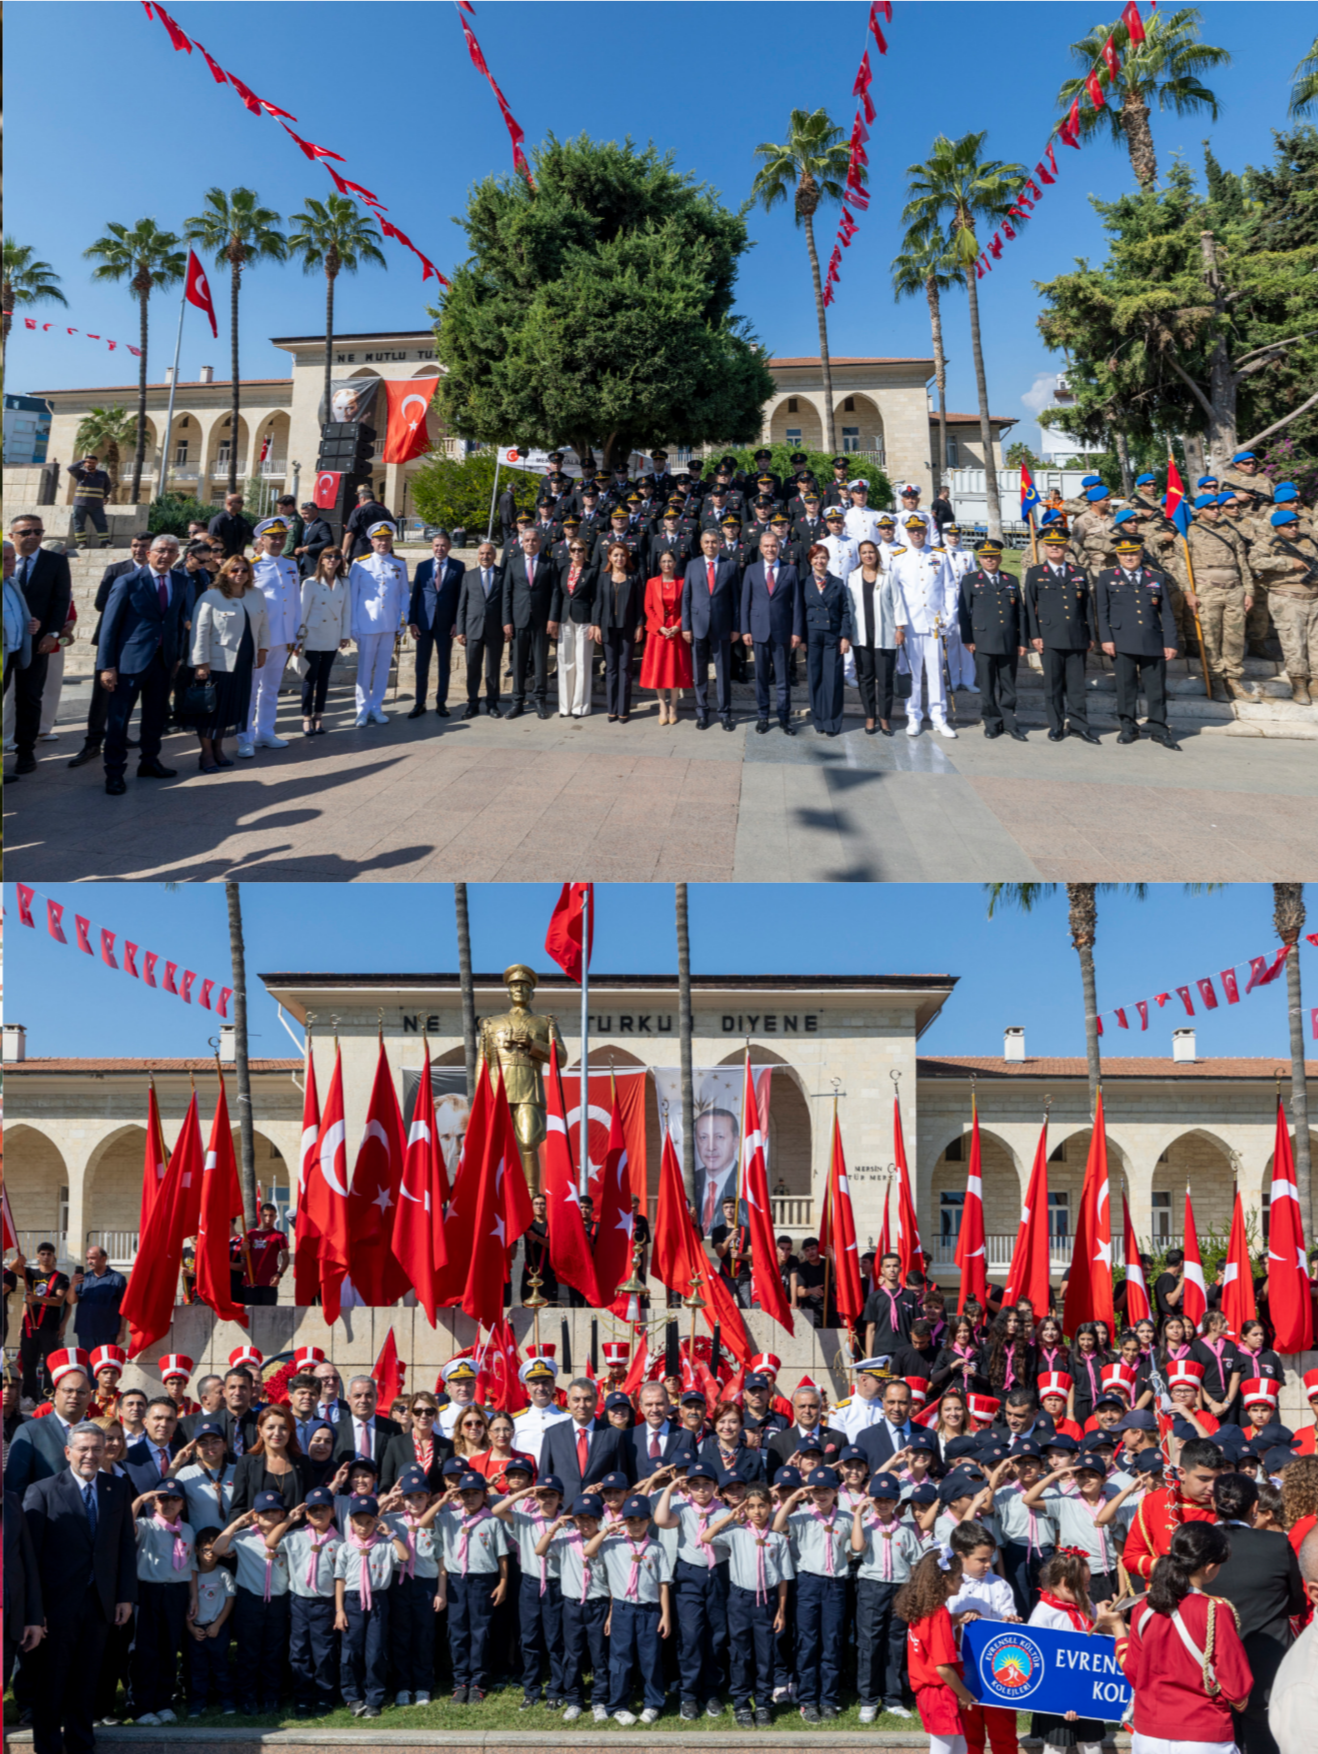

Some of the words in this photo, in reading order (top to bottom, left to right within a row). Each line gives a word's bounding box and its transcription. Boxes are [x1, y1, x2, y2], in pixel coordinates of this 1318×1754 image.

[337, 354, 355, 363] NE
[365, 352, 406, 361] MUTLU
[403, 1015, 439, 1032] NE
[722, 1015, 818, 1032] DİYENE
[985, 1637, 1018, 1661] EVRENSEL
[1019, 1639, 1041, 1668] KÜLTÜR
